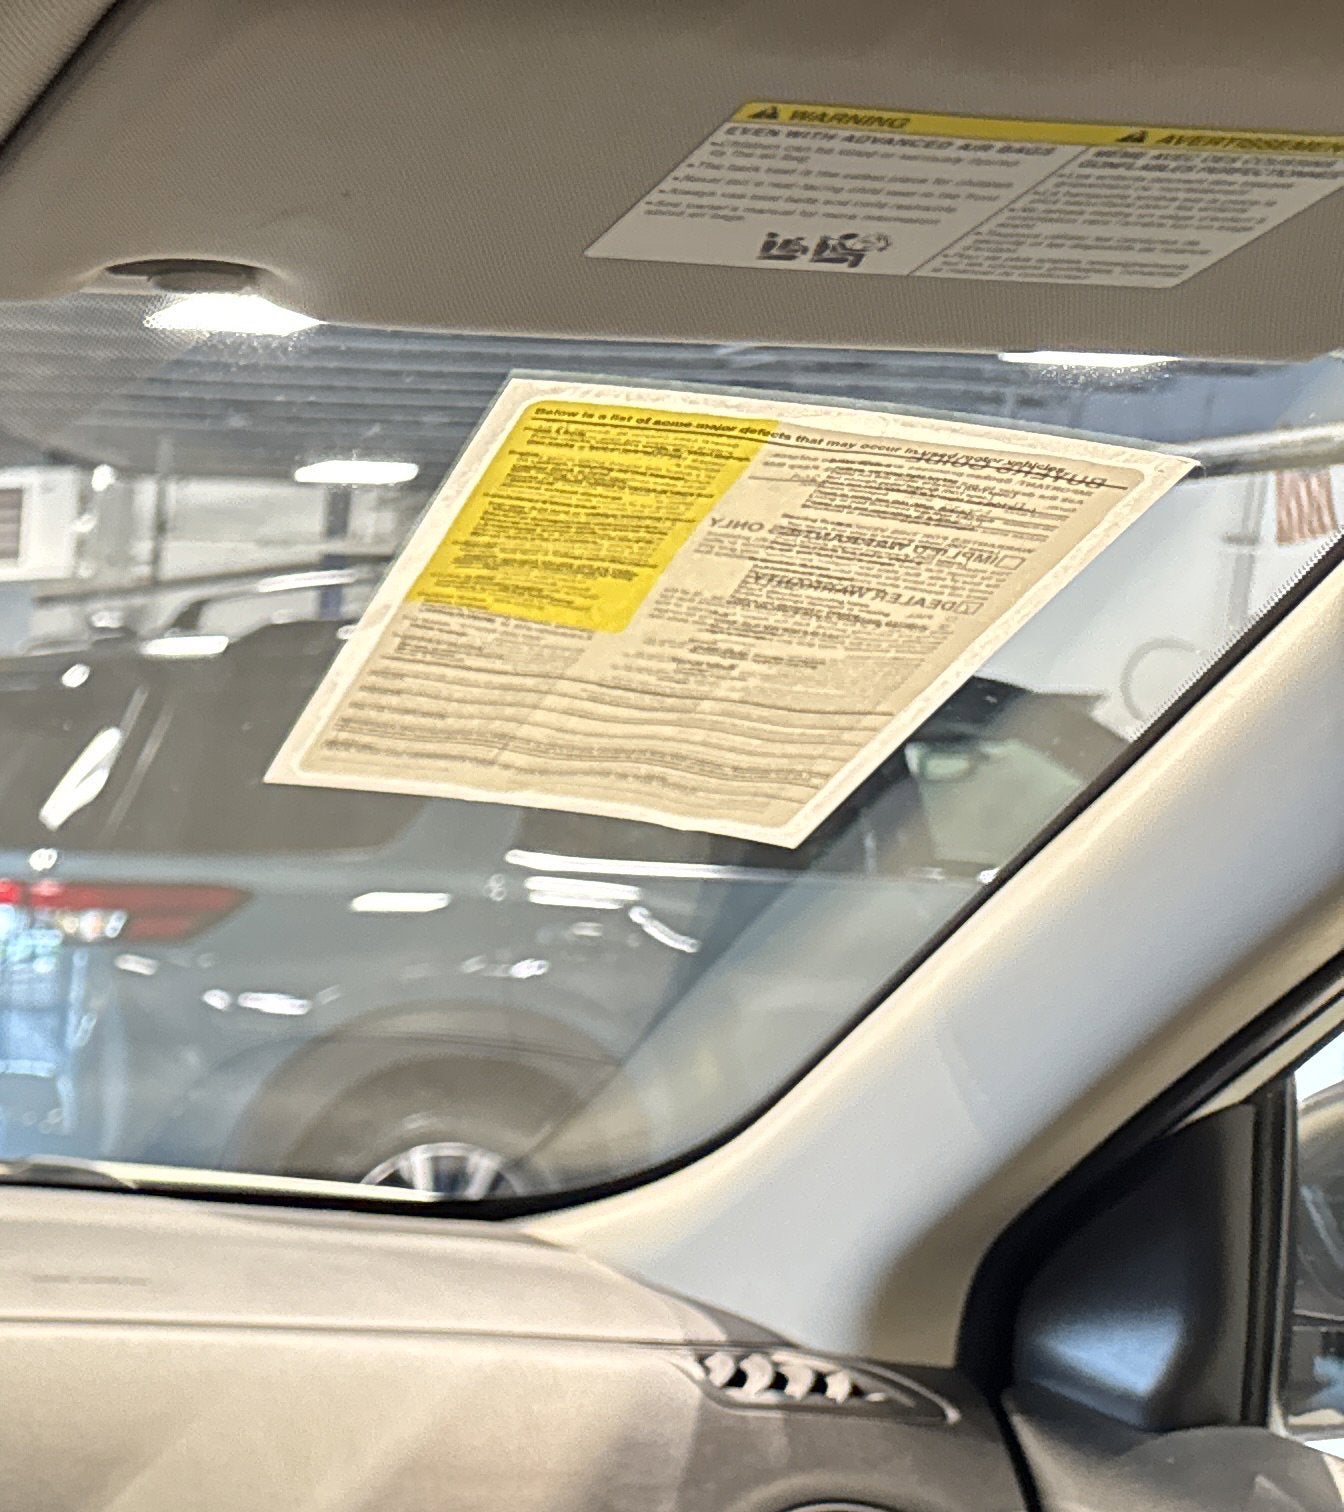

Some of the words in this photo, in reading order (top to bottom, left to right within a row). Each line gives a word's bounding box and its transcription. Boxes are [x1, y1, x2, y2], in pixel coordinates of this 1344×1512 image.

[789, 109, 911, 129] WARNING
[724, 126, 781, 138] EVEN
[785, 130, 838, 142] WITH
[840, 133, 954, 150] ADVANCED
[739, 426, 791, 442] defects
[795, 434, 825, 446] that
[826, 440, 858, 450] may
[859, 442, 902, 453] occur
